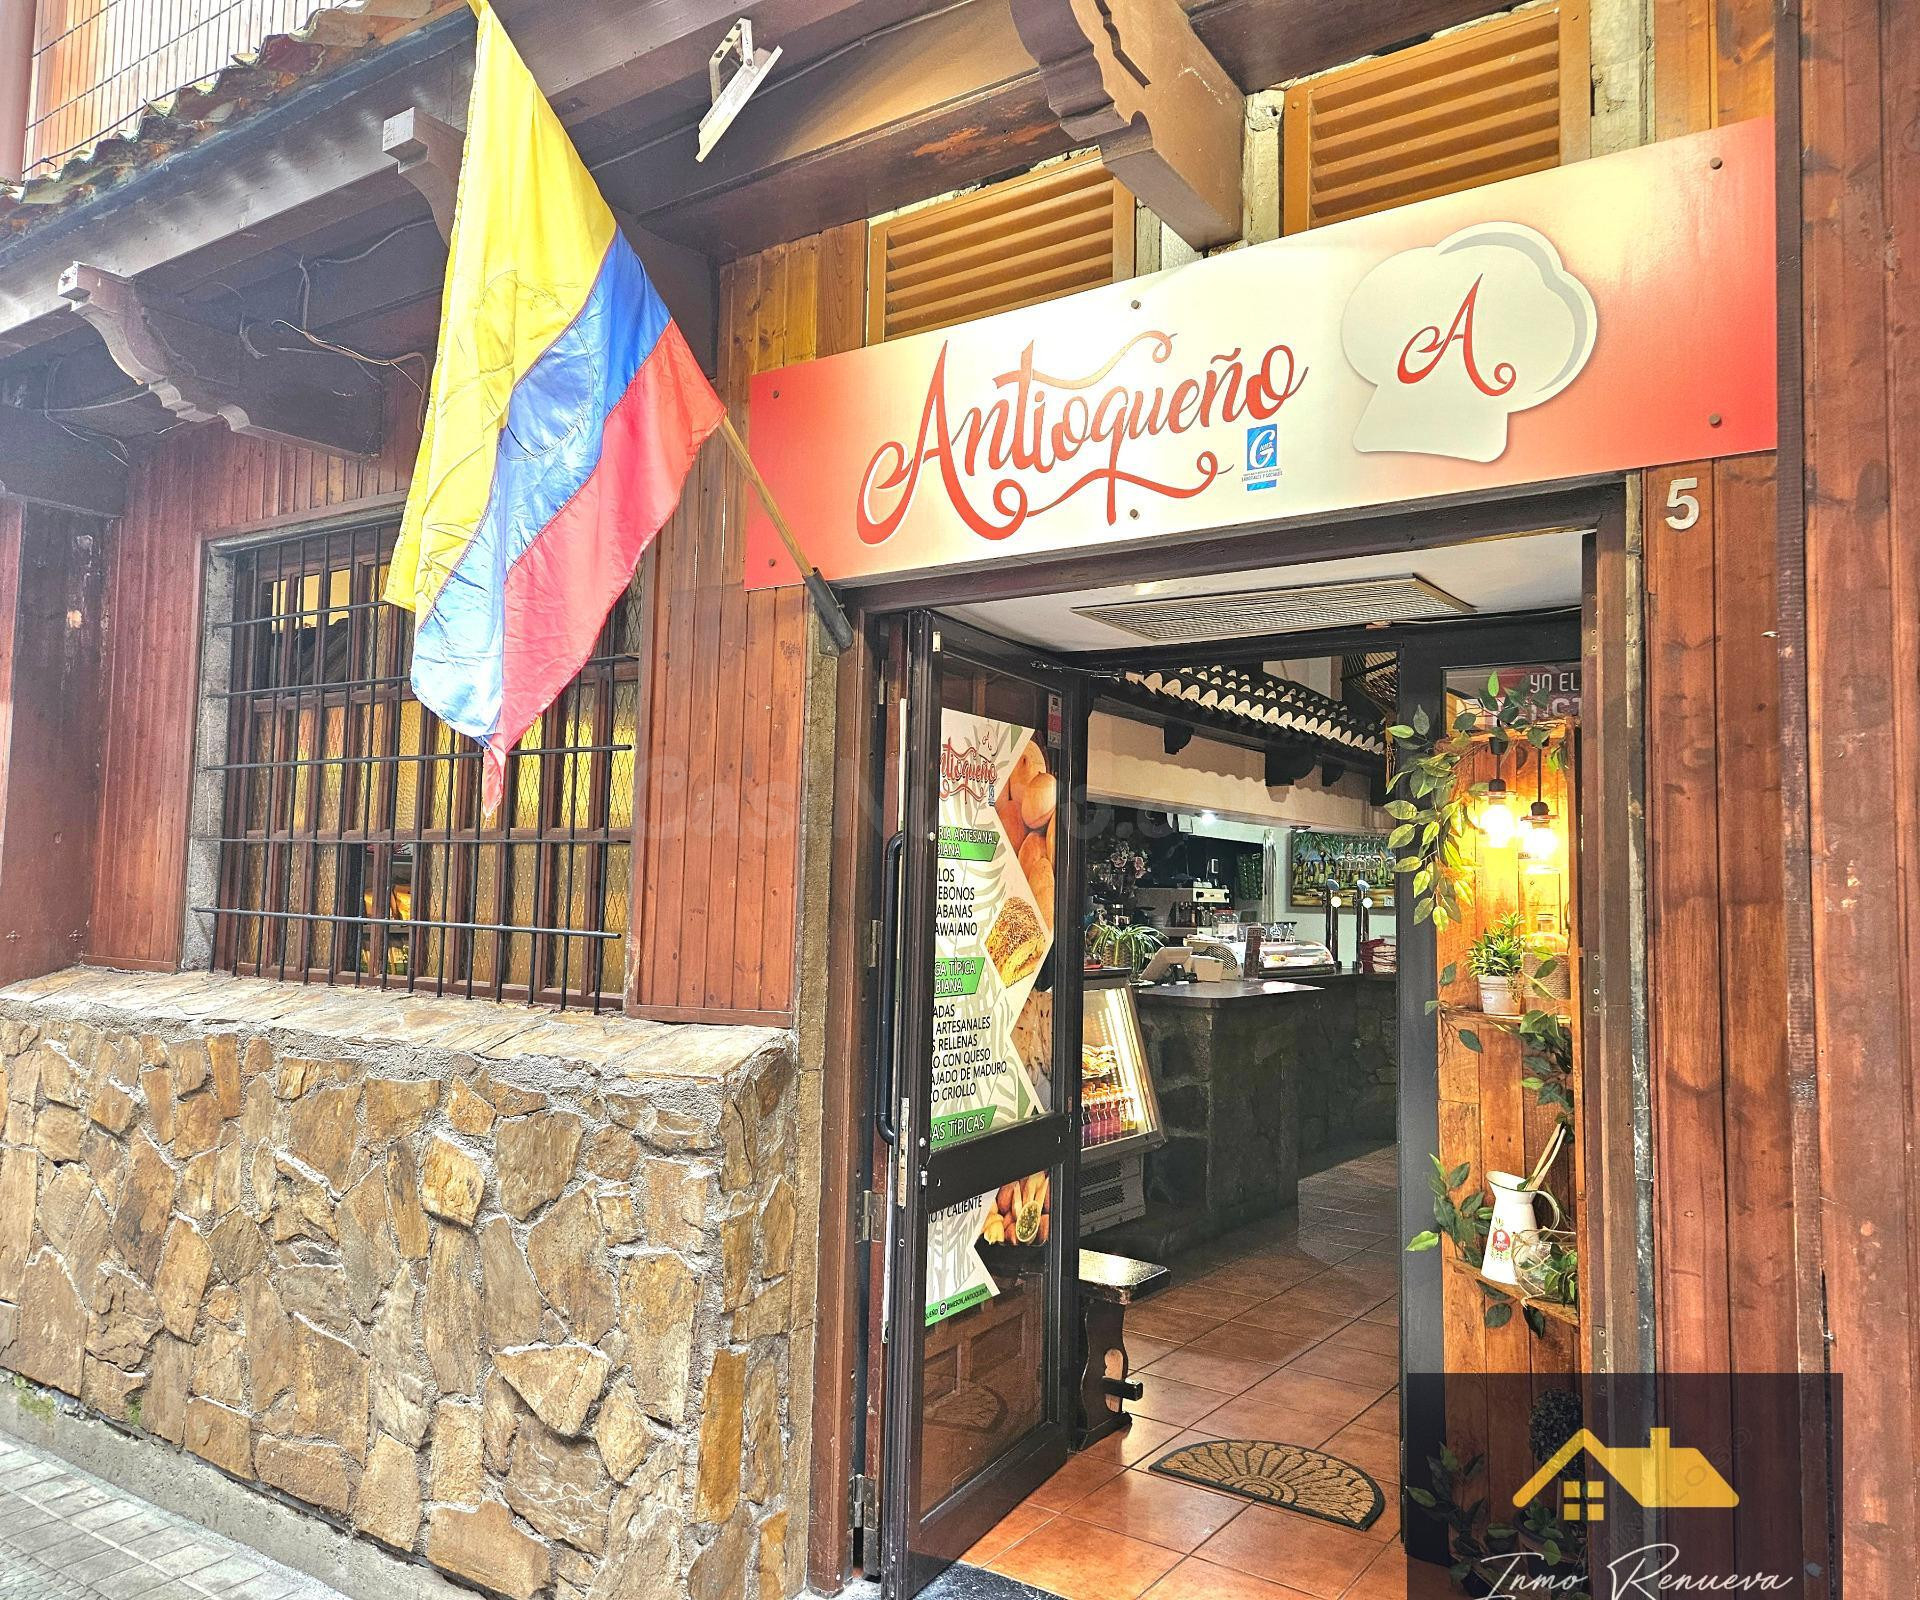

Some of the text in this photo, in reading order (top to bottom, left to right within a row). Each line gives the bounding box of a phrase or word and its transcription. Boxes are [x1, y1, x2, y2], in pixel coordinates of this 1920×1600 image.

[1397, 272, 1517, 397] A
[856, 330, 1309, 545] Antioqueño
[1664, 477, 1700, 530] 5
[1560, 672, 1579, 691] EL
[954, 828, 997, 845] ARTESANAL
[938, 868, 955, 883] LOS
[938, 886, 975, 901] EBONOS
[935, 904, 973, 918] ABANAS
[935, 1016, 991, 1035] ARTESANALES
[938, 1034, 978, 1052] RELLENAS
[943, 1053, 961, 1067] CON
[963, 1048, 991, 1065] QUESO
[960, 1067, 971, 1081] DE
[973, 1061, 1007, 1078] MADURO
[942, 1083, 977, 1101] CRIOLLO
[947, 1195, 983, 1218] CALIENTE
